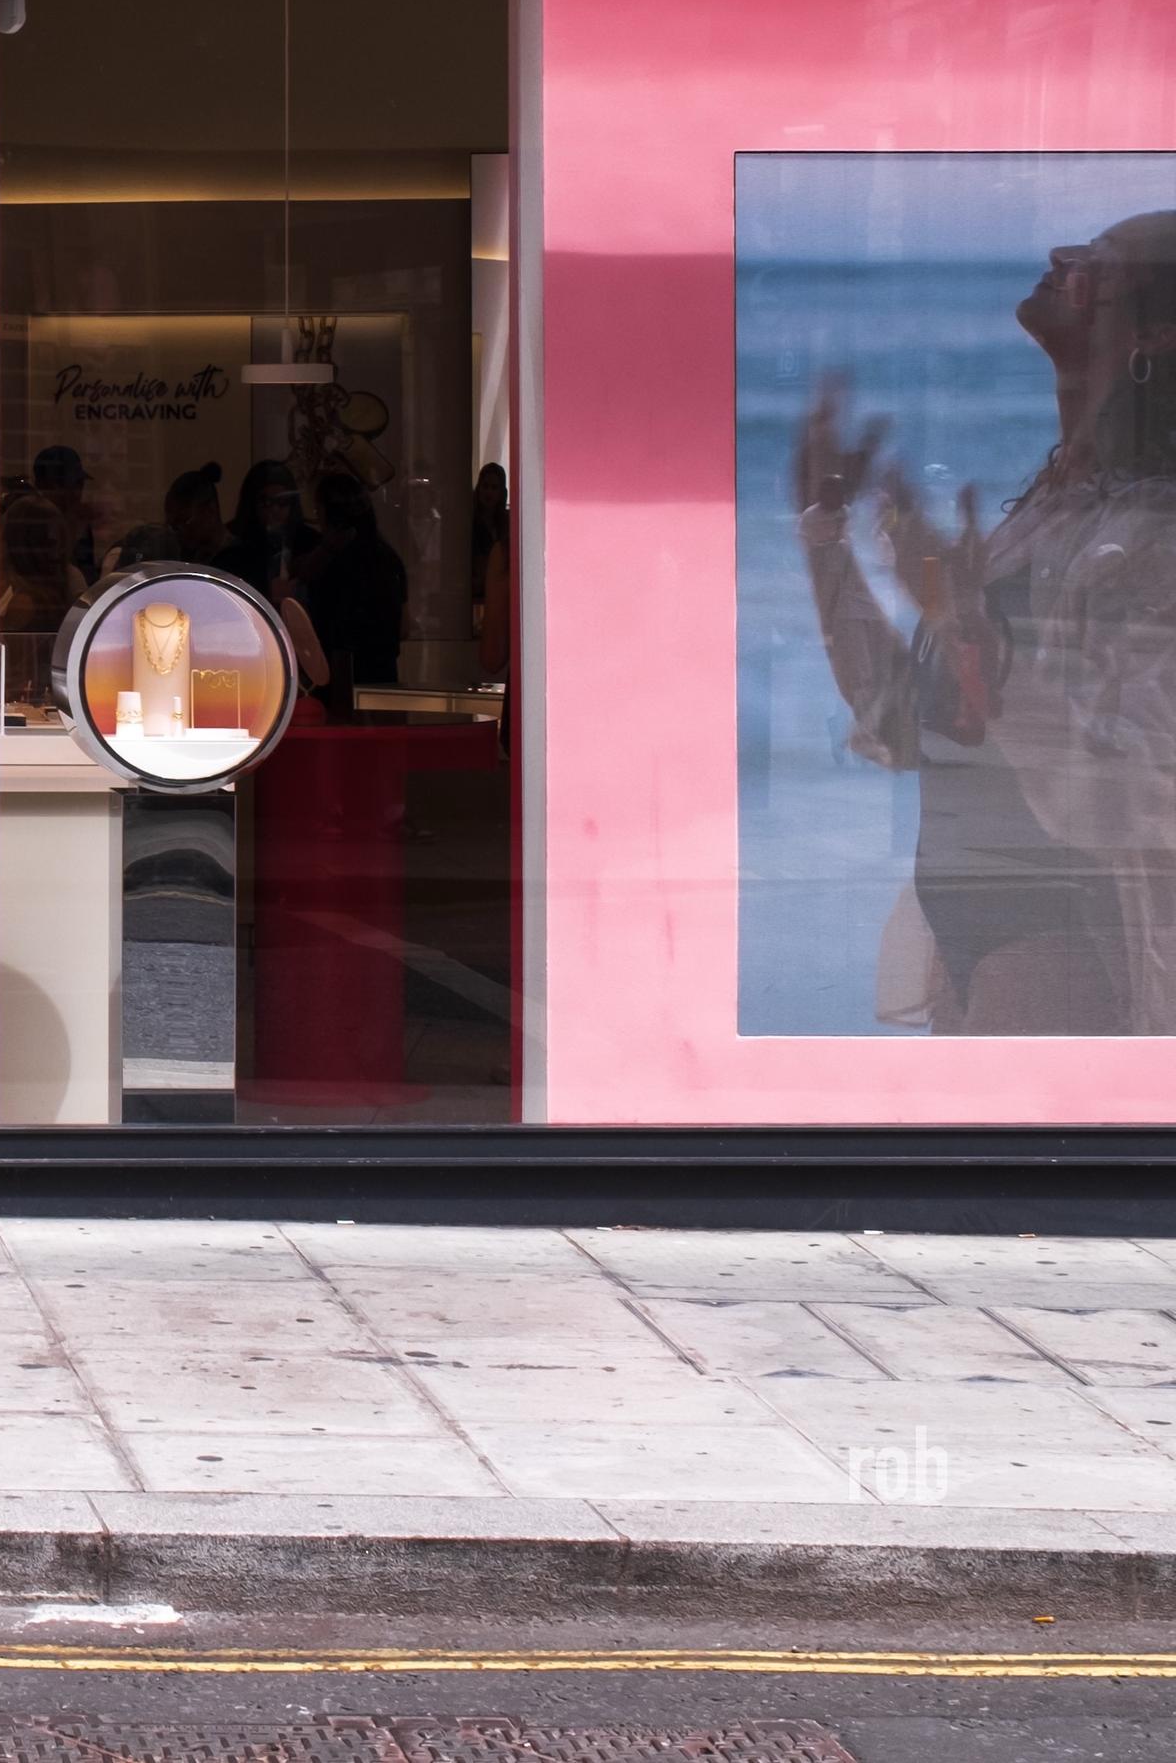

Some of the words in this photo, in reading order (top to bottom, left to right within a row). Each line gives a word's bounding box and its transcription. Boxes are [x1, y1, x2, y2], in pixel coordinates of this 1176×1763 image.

[52, 364, 170, 404] Personalise
[173, 364, 230, 399] with
[74, 404, 198, 420] ENGRAVING
